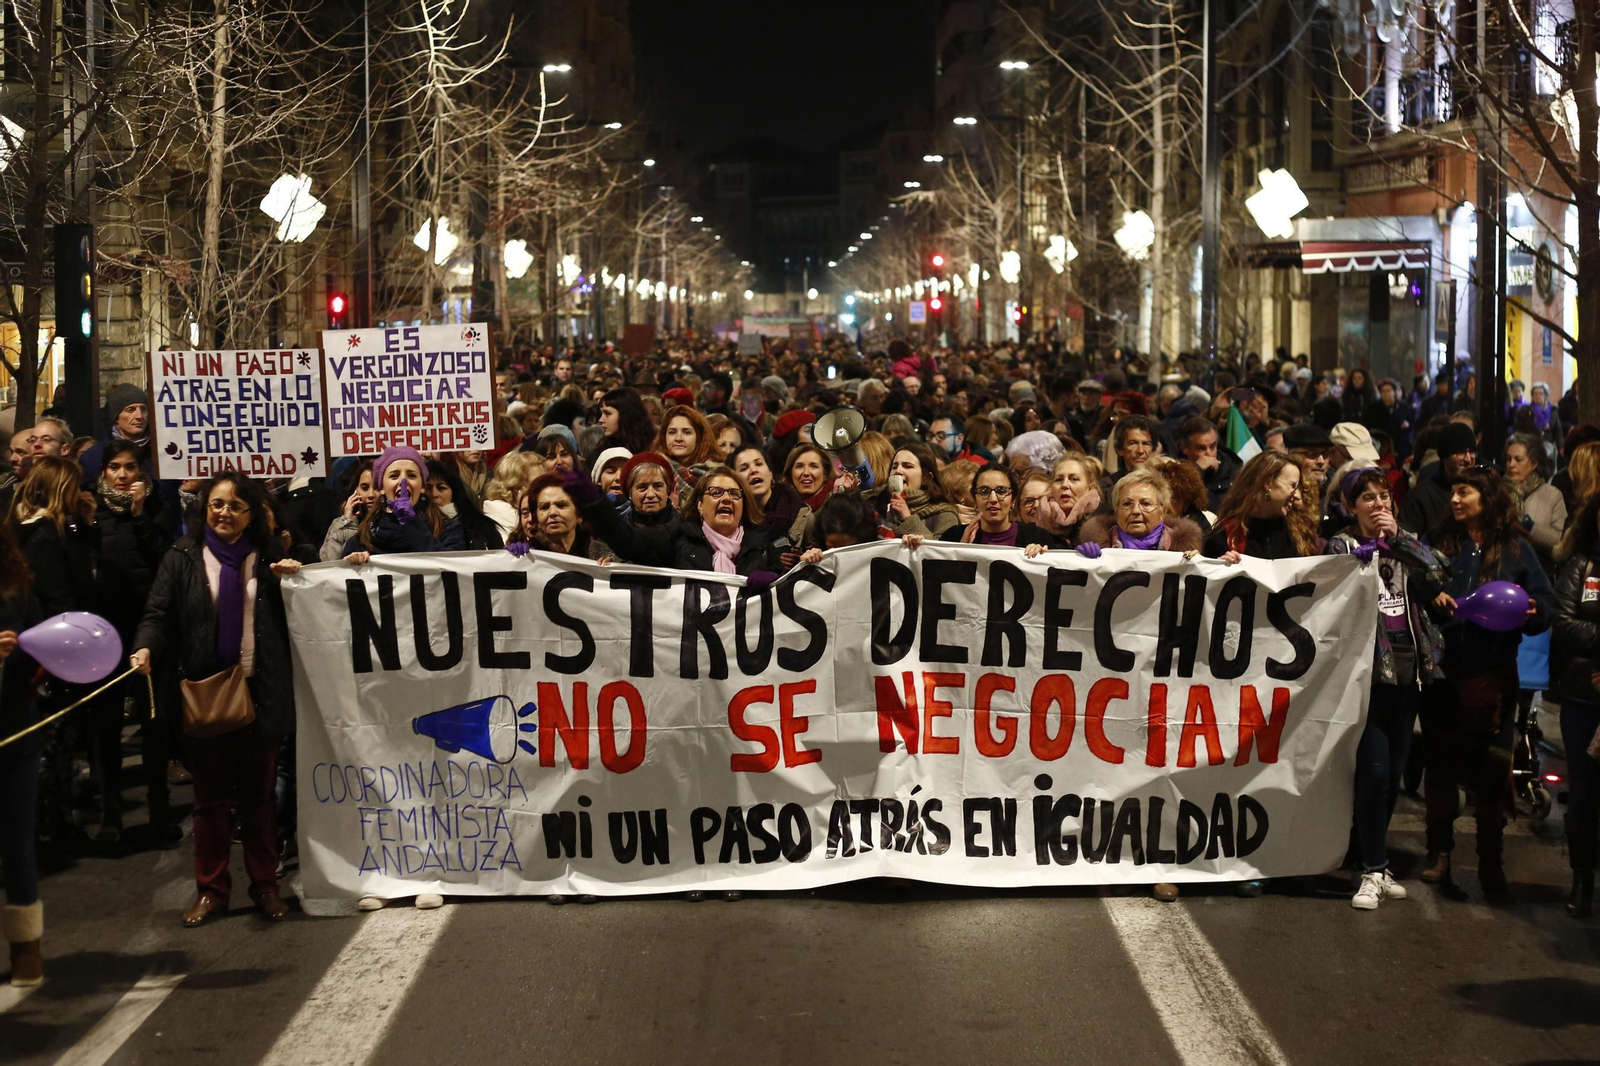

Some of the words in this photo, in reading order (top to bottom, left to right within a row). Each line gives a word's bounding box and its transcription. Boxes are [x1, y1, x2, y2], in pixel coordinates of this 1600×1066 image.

[385, 328, 419, 351] ES
[196, 353, 222, 376] UN
[236, 351, 294, 376] PASO
[329, 351, 486, 380] VERGONZOSO
[157, 378, 230, 402] ATRAS
[238, 378, 271, 400] EN
[281, 374, 312, 400] LO
[330, 406, 375, 430] CON
[378, 401, 490, 428] NUESTROS
[187, 428, 271, 453] SOBRE
[343, 427, 470, 454] DERECHOS
[345, 565, 838, 680] NUESTROS
[869, 556, 1317, 680] DERECHOS
[537, 680, 648, 774] NO
[727, 679, 823, 773] SE
[873, 670, 1291, 768] NEGOCIAN
[313, 762, 529, 804] COORDINADORA
[359, 806, 512, 842] FEMINISTA
[608, 808, 671, 866] UN
[690, 802, 813, 865] PASO
[824, 784, 952, 859] ATRÁS
[964, 797, 1018, 858] EN
[359, 839, 524, 877] ANDALUZA
